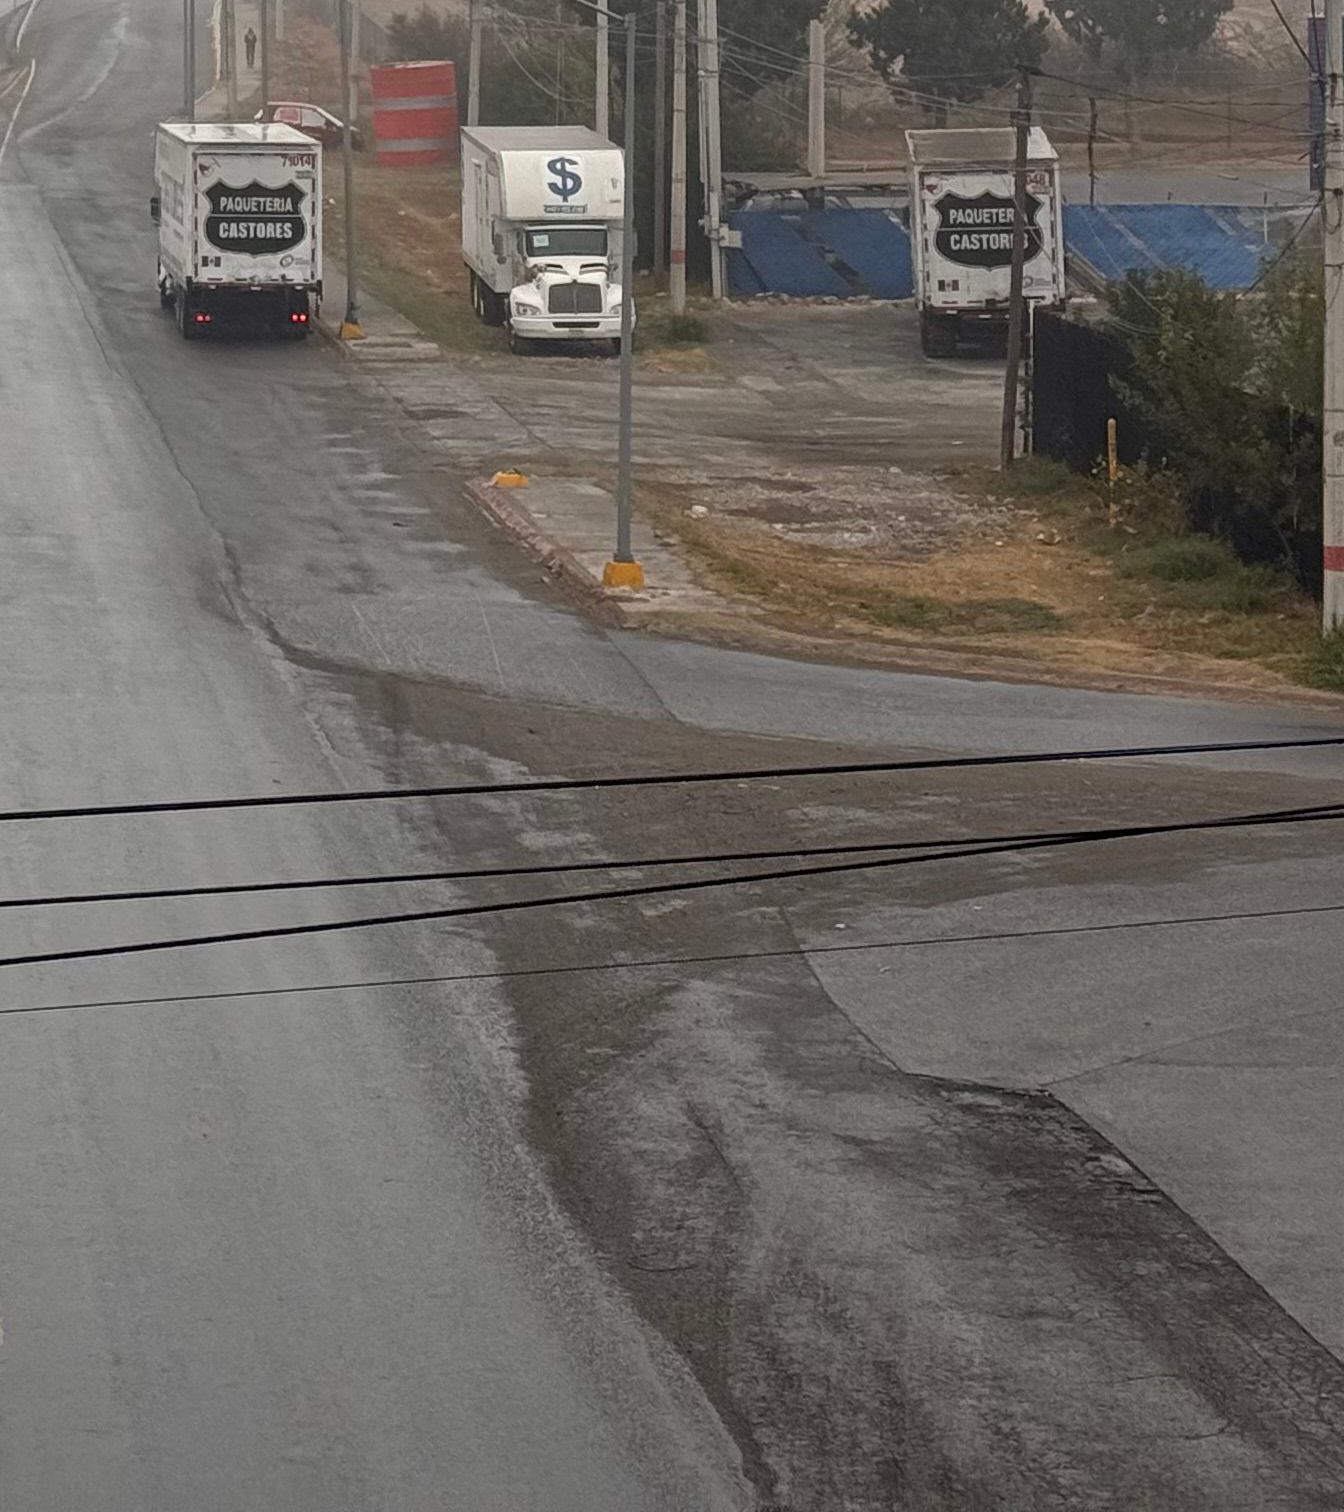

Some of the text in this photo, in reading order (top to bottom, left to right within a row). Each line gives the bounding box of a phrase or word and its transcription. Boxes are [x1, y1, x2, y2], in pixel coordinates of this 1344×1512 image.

[219, 196, 294, 213] PAQUETERIA
[949, 207, 1029, 224] PAQUETER
[218, 222, 293, 239] CASTORES
